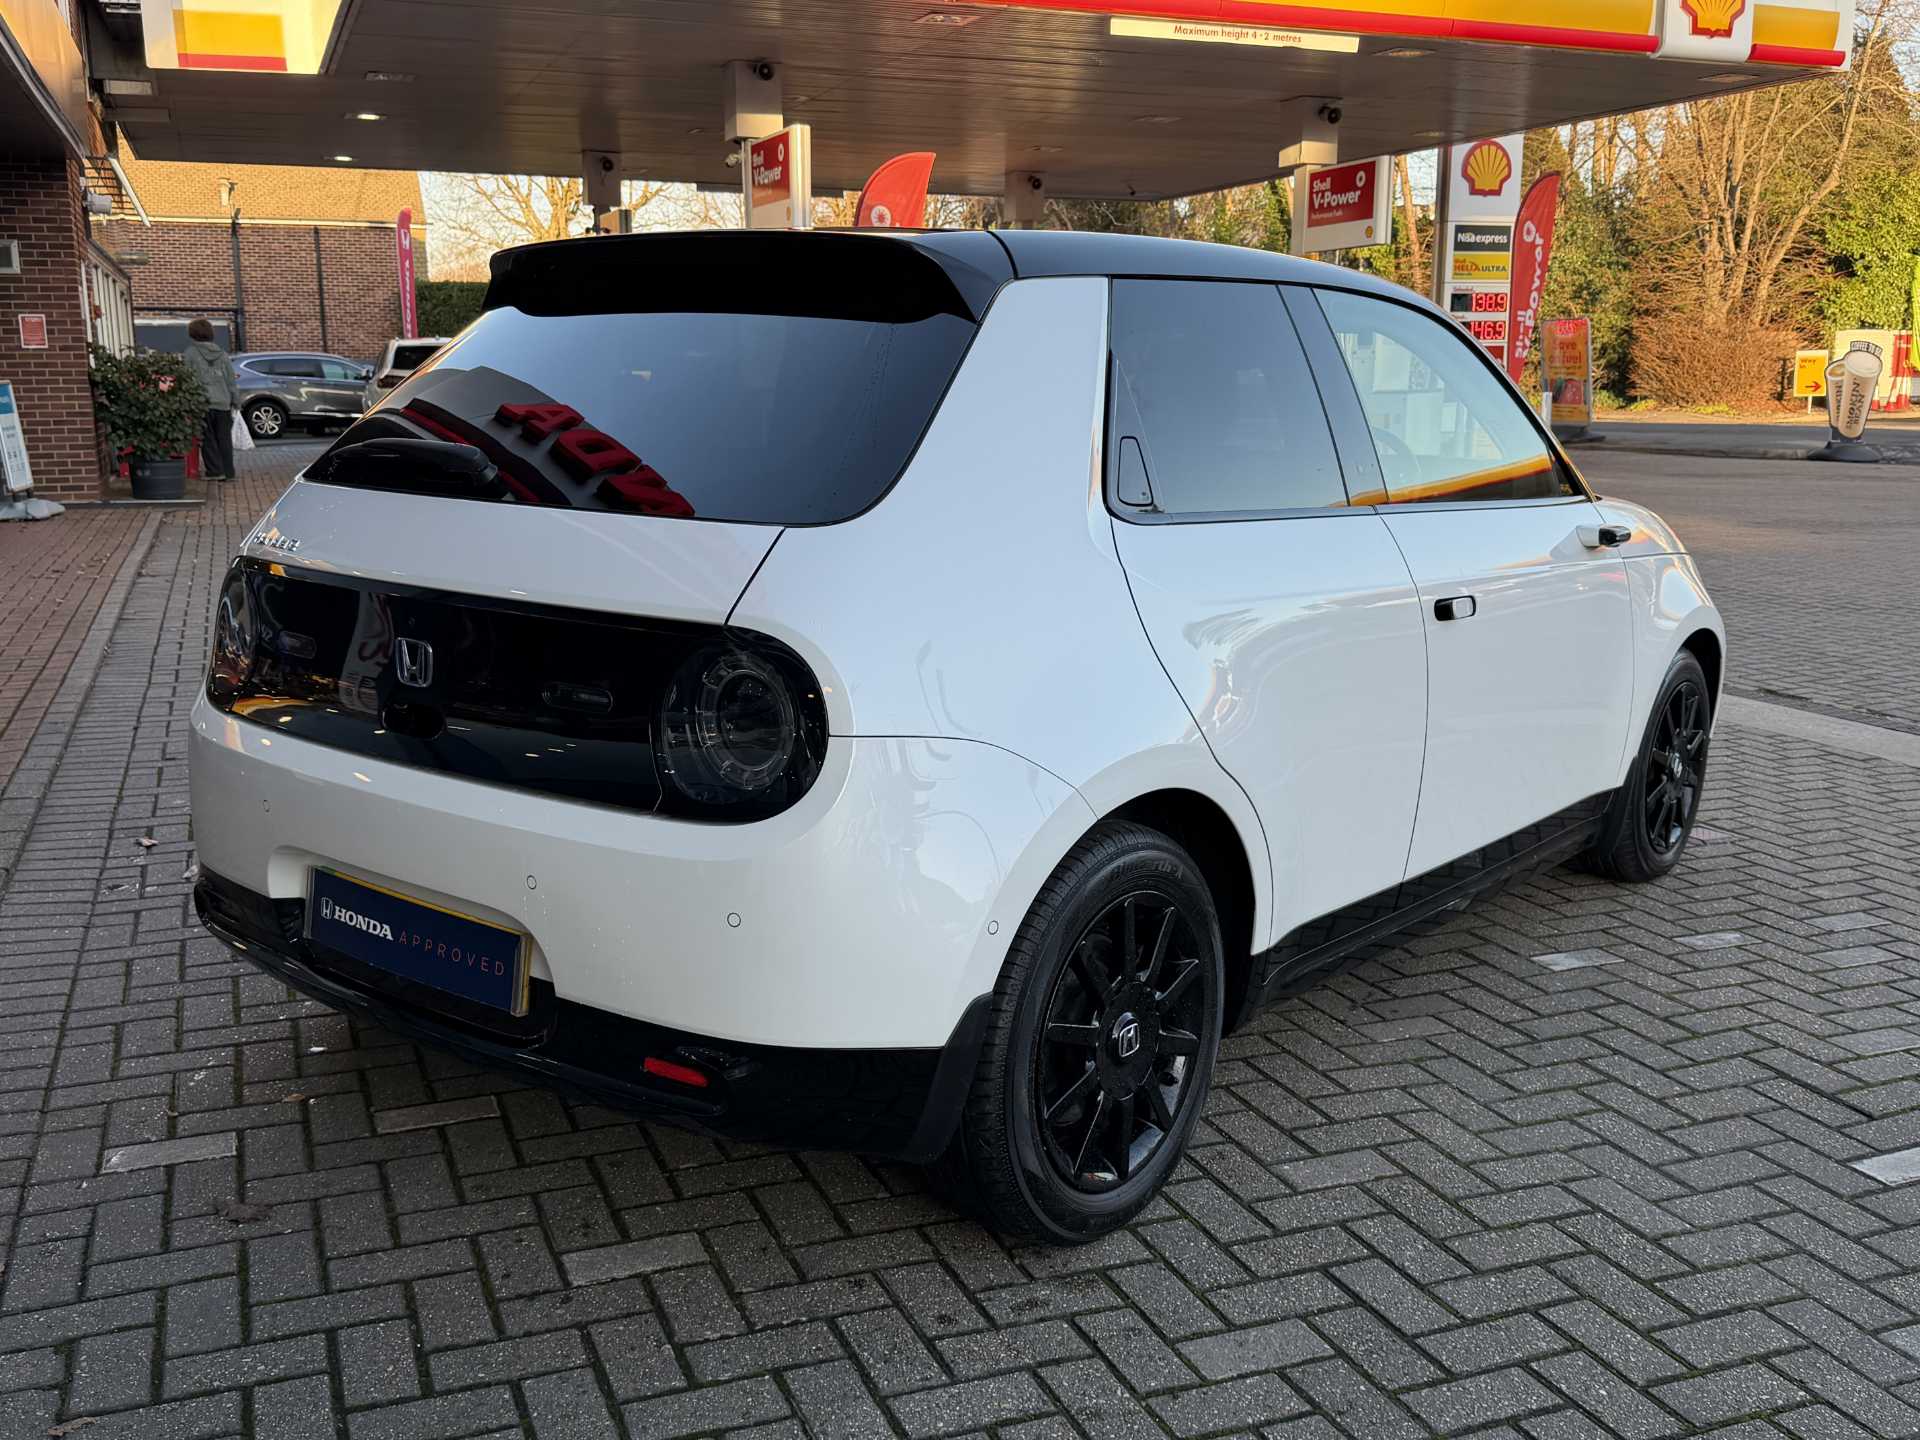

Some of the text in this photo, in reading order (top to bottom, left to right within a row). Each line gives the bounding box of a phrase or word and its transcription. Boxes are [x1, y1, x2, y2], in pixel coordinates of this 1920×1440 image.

[1174, 24, 1219, 38] Maximum
[1221, 29, 1249, 41] height
[1272, 34, 1302, 43] metres
[1313, 176, 1332, 192] Shell
[1312, 189, 1361, 210] V-Power
[1481, 264, 1507, 273] ULTRA
[1471, 293, 1507, 312] 138.9
[1470, 320, 1505, 340] 146.9
[333, 905, 505, 976] HONDA APPROVED
